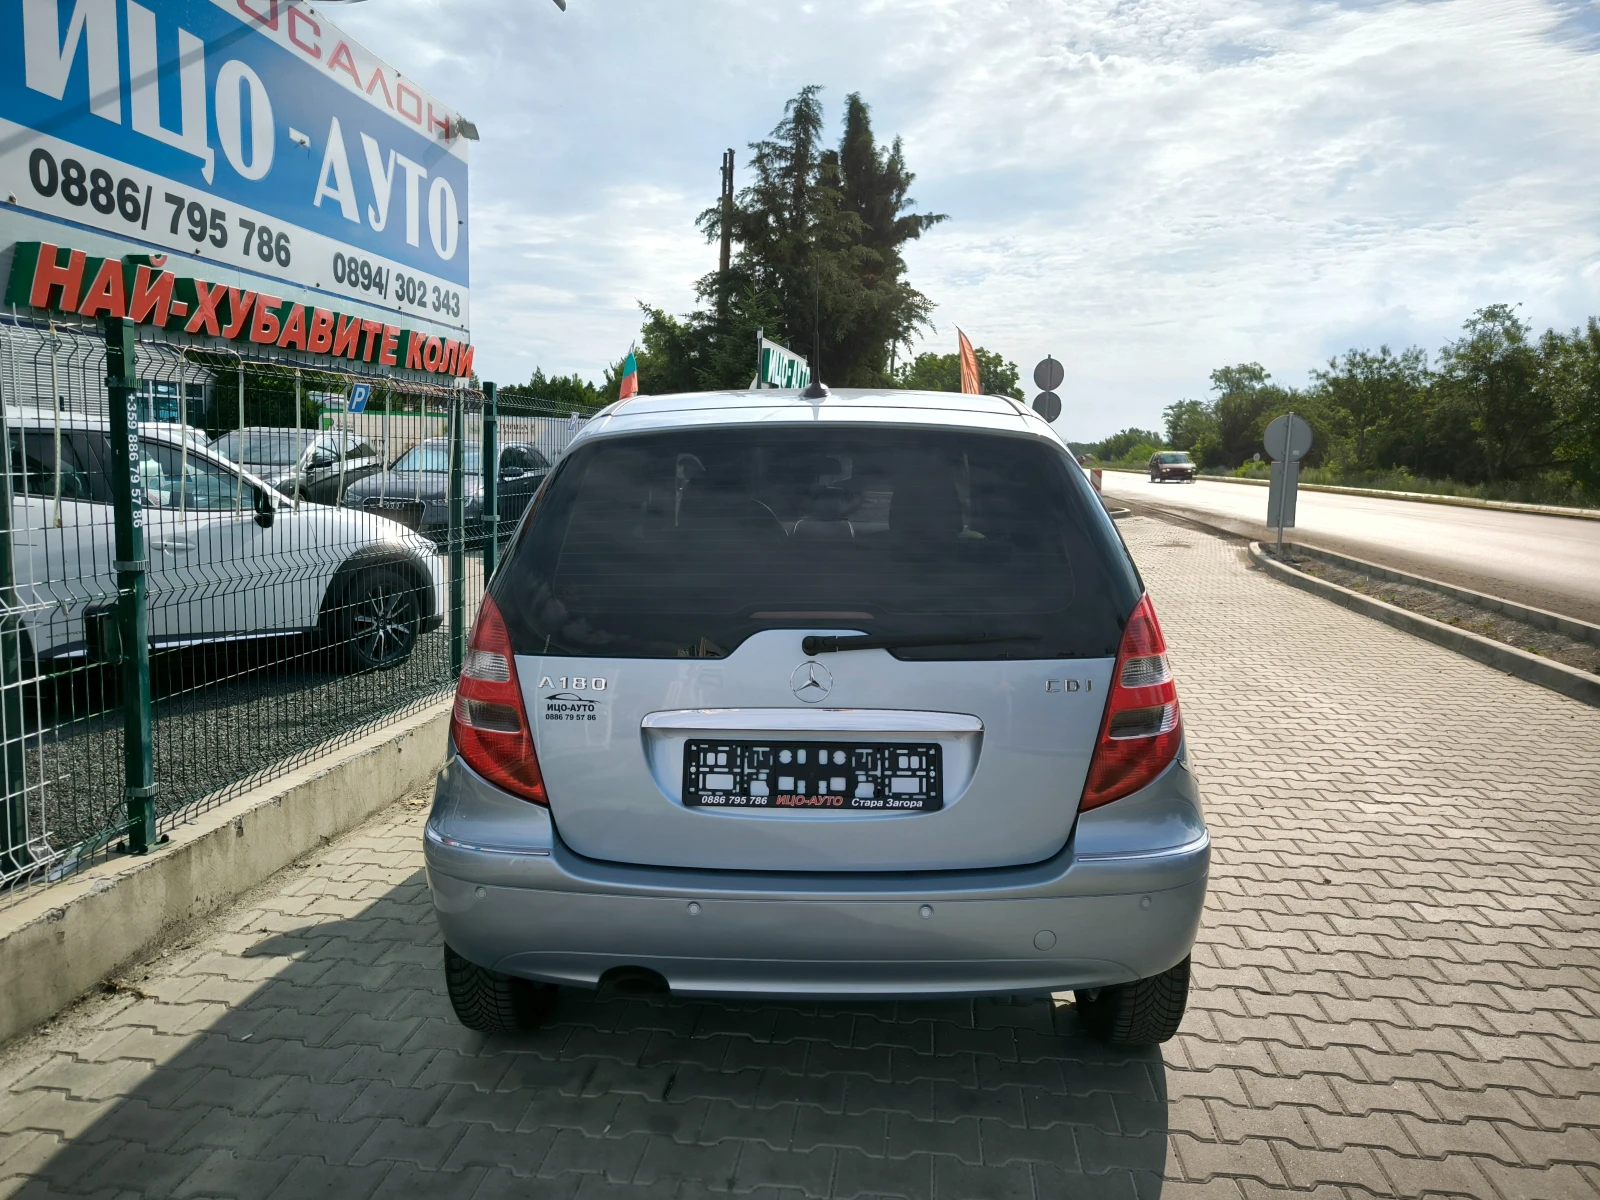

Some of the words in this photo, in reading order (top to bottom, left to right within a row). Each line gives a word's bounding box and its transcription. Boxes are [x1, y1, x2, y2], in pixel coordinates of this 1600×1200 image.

[164, 192, 228, 249] 795
[238, 217, 291, 268] 786
[394, 272, 427, 309] 302
[431, 285, 460, 318] 343
[29, 241, 401, 366] НАЙ-ХУБАВИТЕ
[405, 330, 475, 378] КОЛИ
[351, 387, 366, 410] P
[127, 393, 138, 430] +359
[128, 434, 139, 461] 886
[130, 465, 140, 484] 79
[131, 488, 142, 506] 57
[133, 510, 143, 529] 86
[537, 676, 608, 691] A180
[1044, 679, 1093, 693] CDI
[545, 713, 563, 721] 0886
[565, 713, 574, 721] 79
[546, 703, 595, 713] ИЦО-АУТО
[701, 795, 726, 804] 0886
[728, 796, 747, 805] 795
[749, 796, 768, 805] 786
[775, 794, 844, 807] ИЦО-АУТО
[851, 797, 884, 808] Стара
[885, 798, 924, 809] Загора
